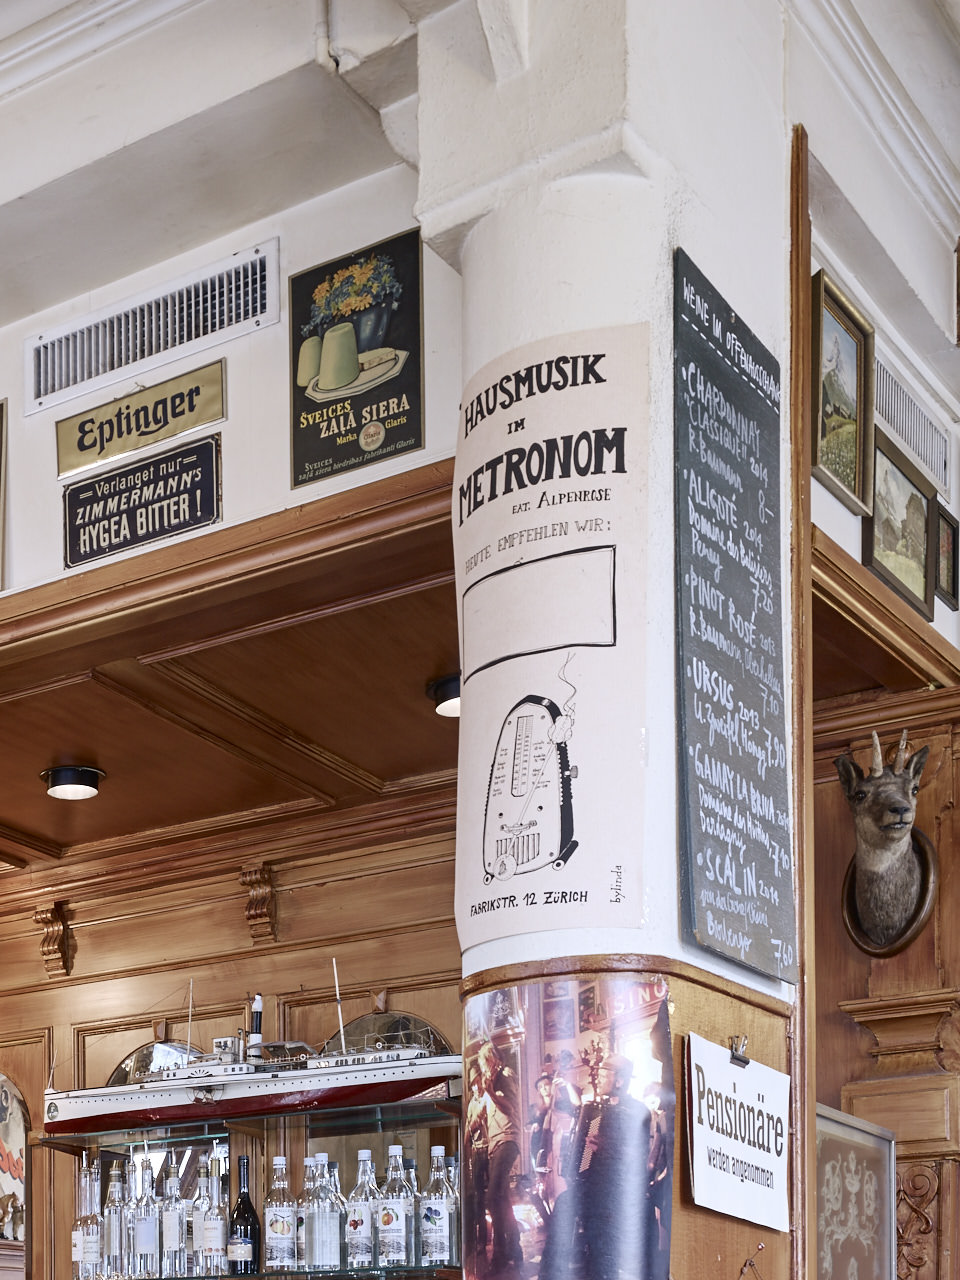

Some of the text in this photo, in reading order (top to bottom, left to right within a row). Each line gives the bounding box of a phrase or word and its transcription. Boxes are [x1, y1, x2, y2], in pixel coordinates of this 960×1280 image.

[683, 277, 709, 326] WEINE
[712, 314, 722, 343] IM
[77, 385, 201, 455] Eptinger
[300, 400, 351, 428] ŠVEICES
[361, 393, 410, 425] SIERA
[464, 354, 607, 440] HAUSMUSIK
[688, 362, 760, 458] CHARDONNAY
[336, 416, 407, 446] Marka Glaris
[507, 417, 526, 434] IM
[95, 457, 183, 498] Verlanget nur
[458, 427, 628, 528] METRONOM
[537, 488, 612, 509] ALPENROSE
[750, 457, 768, 488] 2014
[79, 513, 131, 555] HYGEA
[136, 493, 190, 537] BITTER
[465, 545, 492, 575] HEUTE
[498, 522, 569, 552] EMPFEHLEN
[743, 521, 763, 553] 2014
[690, 564, 725, 620] PINOT
[692, 656, 734, 711] URSUS
[738, 701, 760, 731] 2013
[695, 742, 734, 800] GAMAY
[736, 773, 749, 805] LA
[470, 890, 589, 917] FABRIKSTR. 12 ZÜRICH
[695, 1062, 784, 1158] Pensionäre
[706, 1145, 774, 1190] werden angenommen
